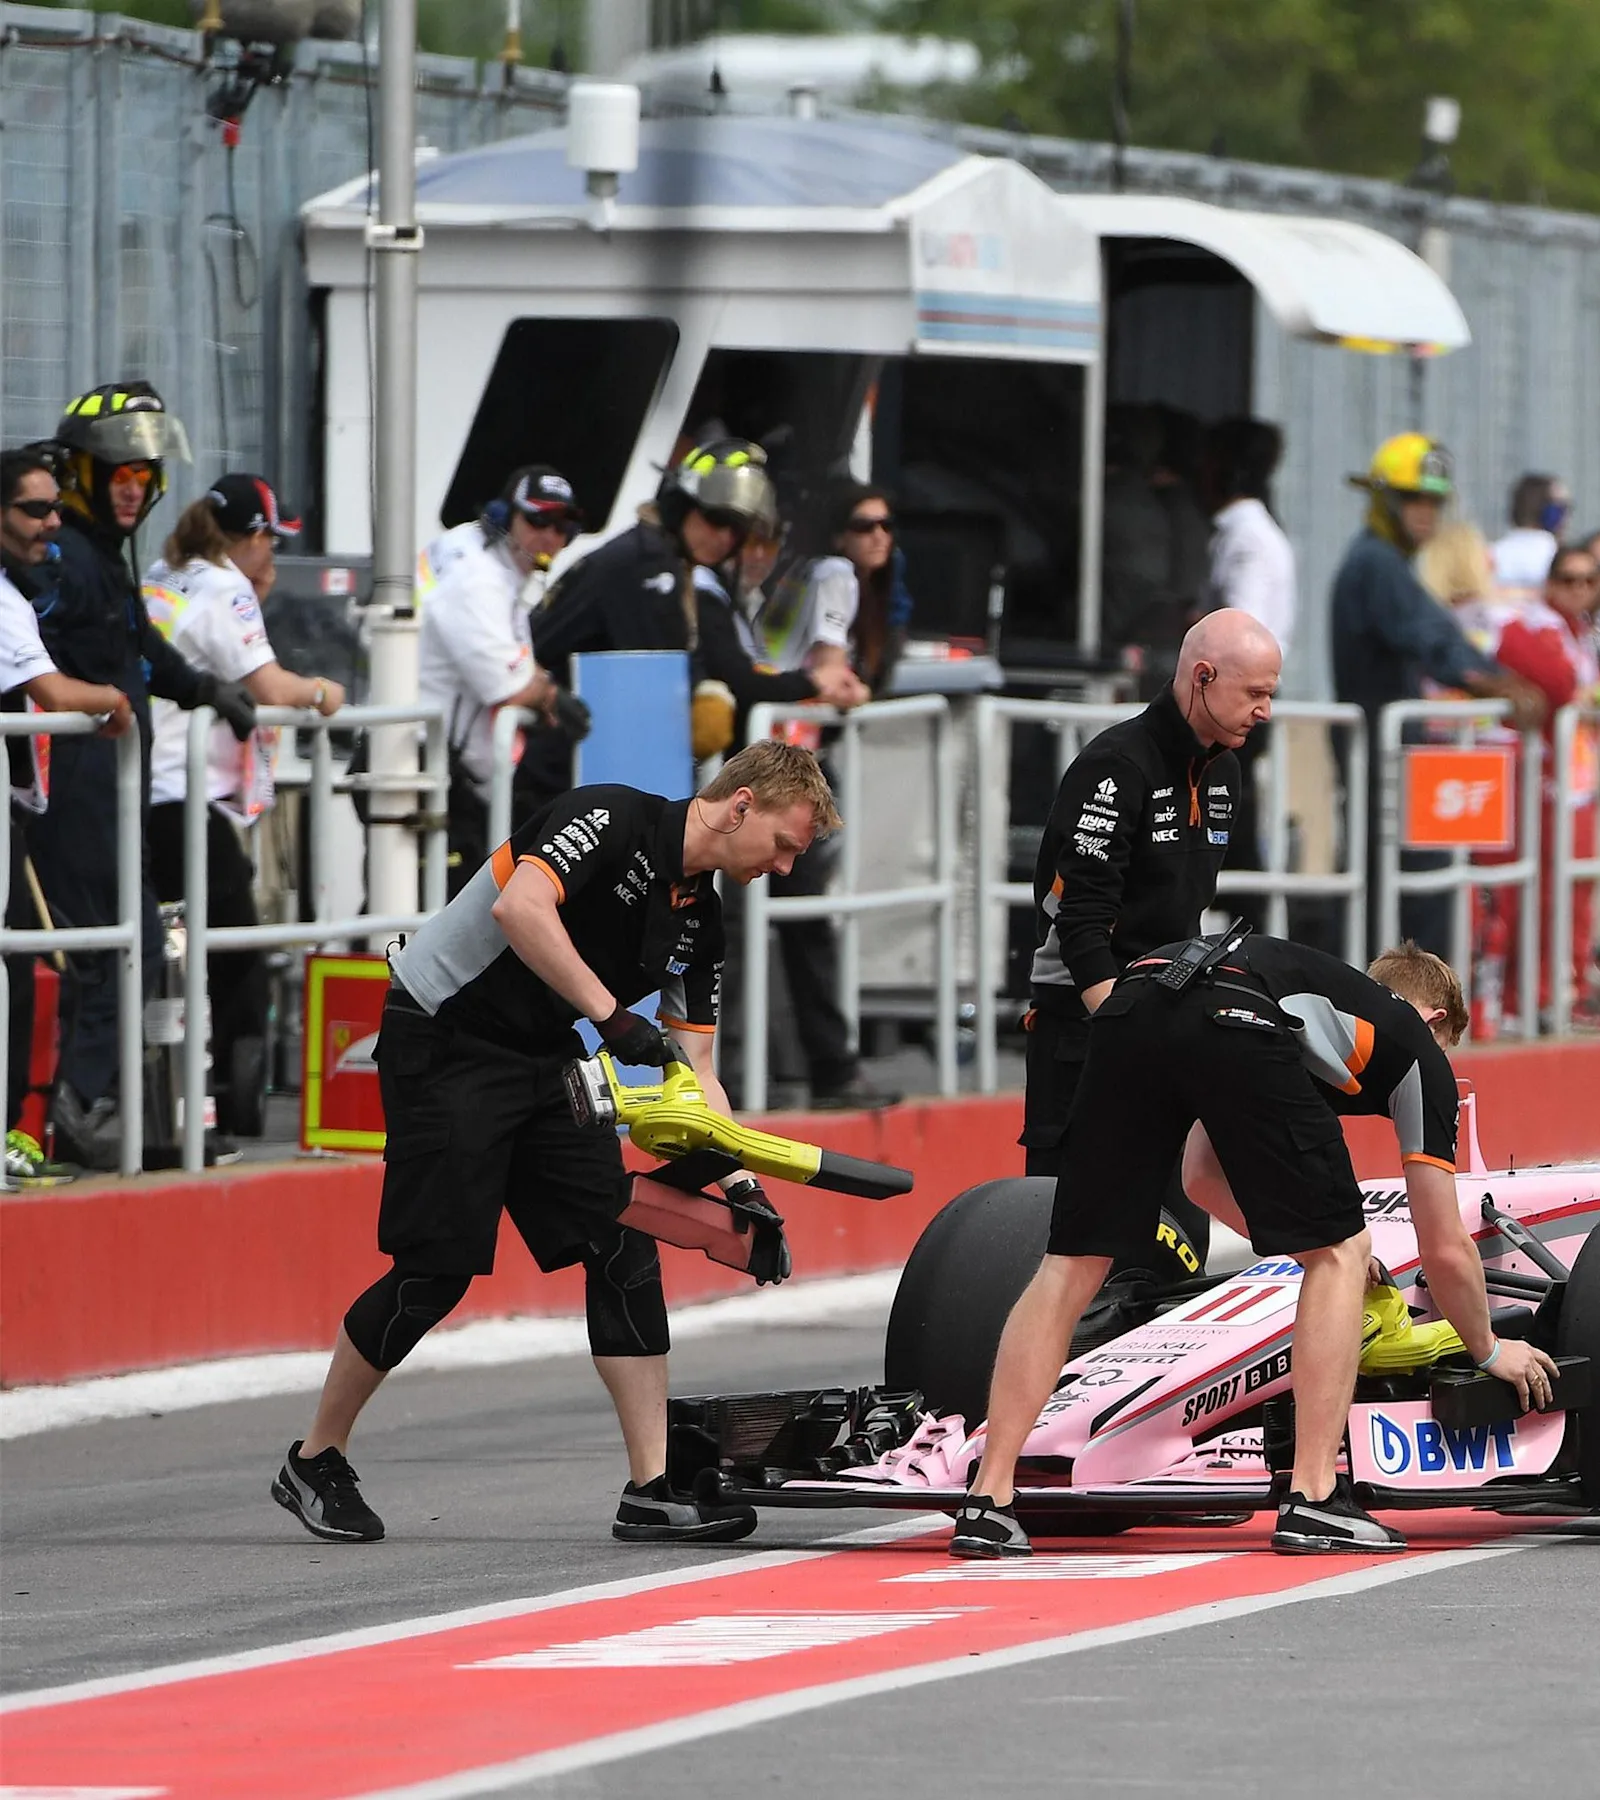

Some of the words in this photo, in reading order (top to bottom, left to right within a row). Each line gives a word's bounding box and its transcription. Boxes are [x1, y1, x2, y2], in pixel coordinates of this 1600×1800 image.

[1093, 792, 1114, 805] INTER
[1079, 813, 1117, 833] HYPE
[561, 824, 594, 853] HYPE
[1152, 828, 1180, 843] NEC
[550, 851, 571, 874] FXTM
[613, 883, 638, 906] NEC
[1156, 1222, 1200, 1273] RO
[1180, 1285, 1287, 1322] 11
[1085, 1352, 1189, 1365] PIRELLI
[1181, 1373, 1242, 1427] SPORT
[1251, 1354, 1288, 1387] BIB
[1221, 1436, 1264, 1446] KIN
[1415, 1419, 1518, 1472] BWT
